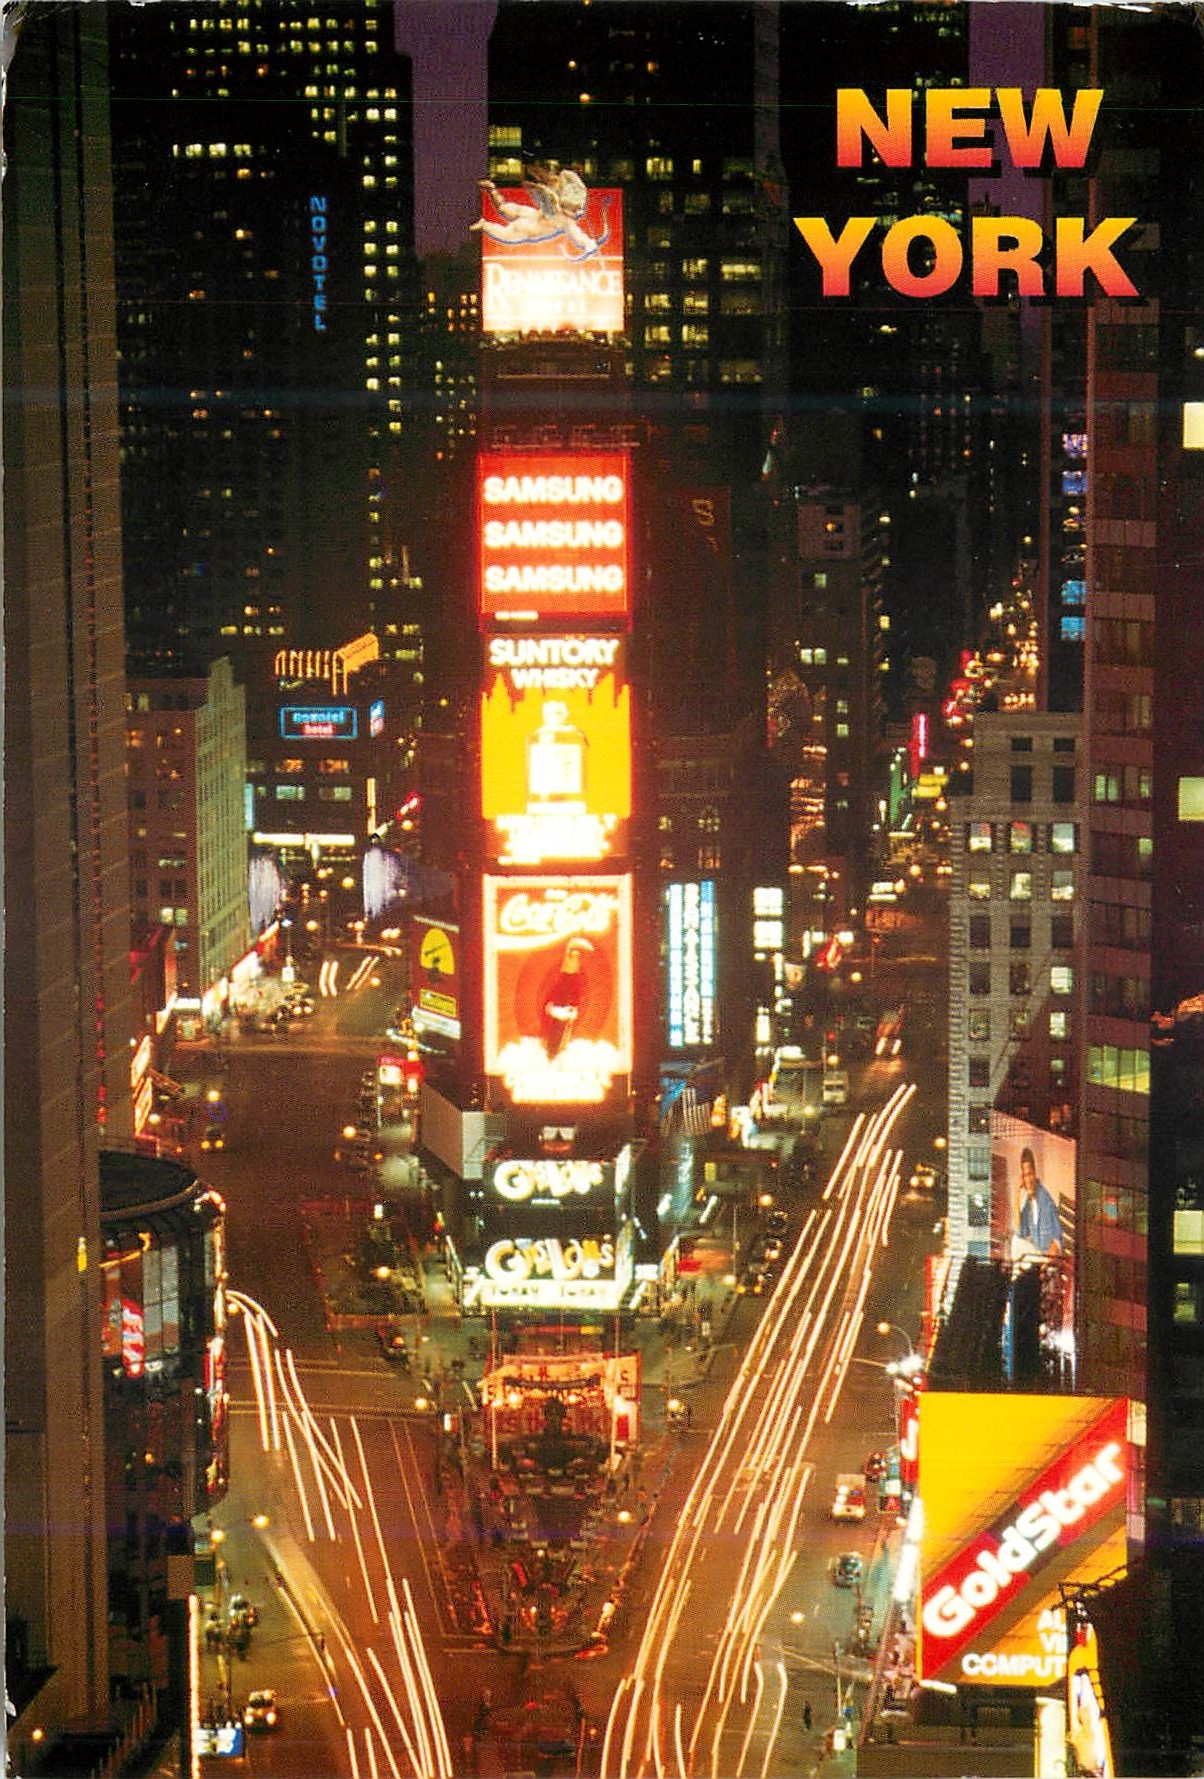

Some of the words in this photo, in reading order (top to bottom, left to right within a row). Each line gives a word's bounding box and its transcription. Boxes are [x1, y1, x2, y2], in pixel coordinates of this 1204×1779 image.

[310, 196, 328, 331] NOVOTEL
[484, 475, 623, 504] SAMSUNG
[485, 520, 624, 549] SAMSUNG
[486, 564, 624, 593] SAMSUNG
[489, 638, 620, 666] SUNTORY
[511, 667, 600, 689] WHISKY
